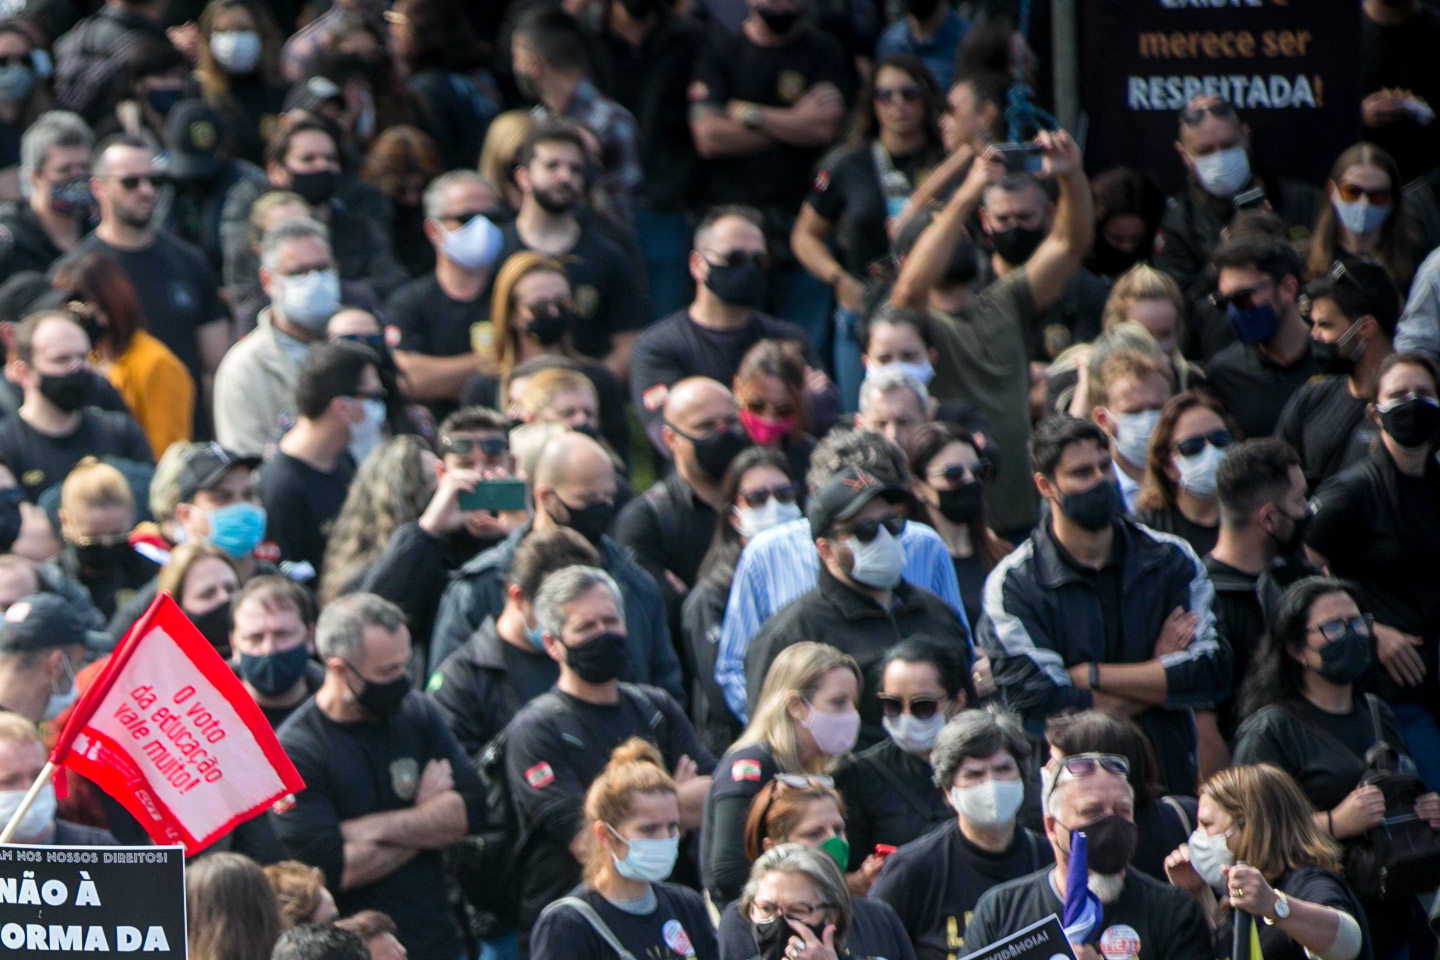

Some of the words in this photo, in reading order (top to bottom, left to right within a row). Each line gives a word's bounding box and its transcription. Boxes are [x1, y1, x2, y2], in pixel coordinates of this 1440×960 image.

[1138, 30, 1256, 58] merece
[1261, 30, 1311, 57] ser
[1127, 74, 1324, 110] RESPEITADA!
[172, 684, 196, 704] O
[186, 701, 226, 744] voto
[113, 702, 150, 740] vale
[142, 739, 201, 795] muito!
[130, 684, 157, 710] da
[151, 706, 223, 784] educação
[16, 850, 43, 862] NOS
[47, 851, 99, 864] NOSSOS
[103, 852, 168, 864] DIREITOS!
[74, 870, 101, 907] À
[116, 925, 171, 952] DA
